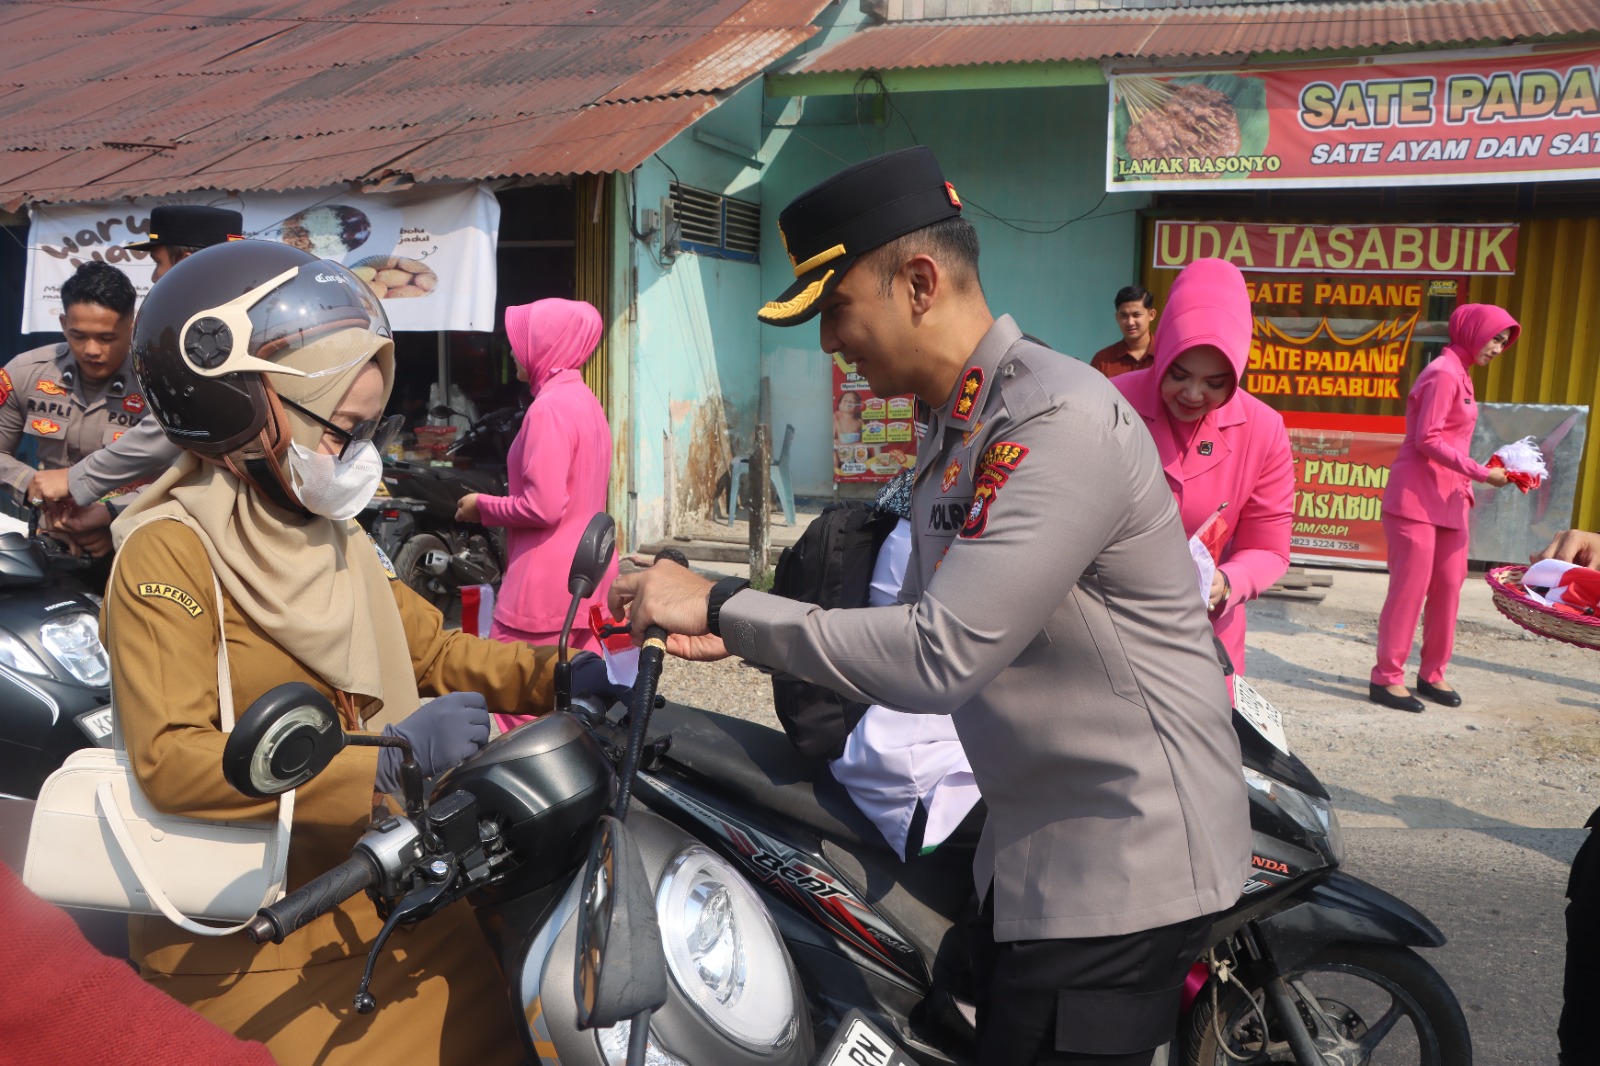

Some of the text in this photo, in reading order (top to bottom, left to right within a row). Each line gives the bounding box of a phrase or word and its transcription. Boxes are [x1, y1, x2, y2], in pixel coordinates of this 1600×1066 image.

[1300, 66, 1600, 129] SATE PADA
[1310, 141, 1384, 165] SATE
[1385, 138, 1472, 163] AYAM
[1475, 134, 1545, 160] DAN
[1118, 154, 1282, 176] LAMAK RASONYO
[398, 235, 430, 244] jadul
[1160, 224, 1515, 271] UDA TASABUIK
[1246, 282, 1423, 307] SATE PADANG
[1248, 338, 1401, 374] SATE PADANG
[1247, 373, 1401, 400] UDA TASABUIK
[26, 398, 73, 417] RAFLI
[107, 410, 141, 428] POL
[1293, 490, 1383, 522] TASABUI
[1312, 539, 1335, 548] 5224
[1337, 541, 1360, 550] 7558
[144, 584, 199, 614] BAPENDA
[1252, 855, 1289, 874] NDA
